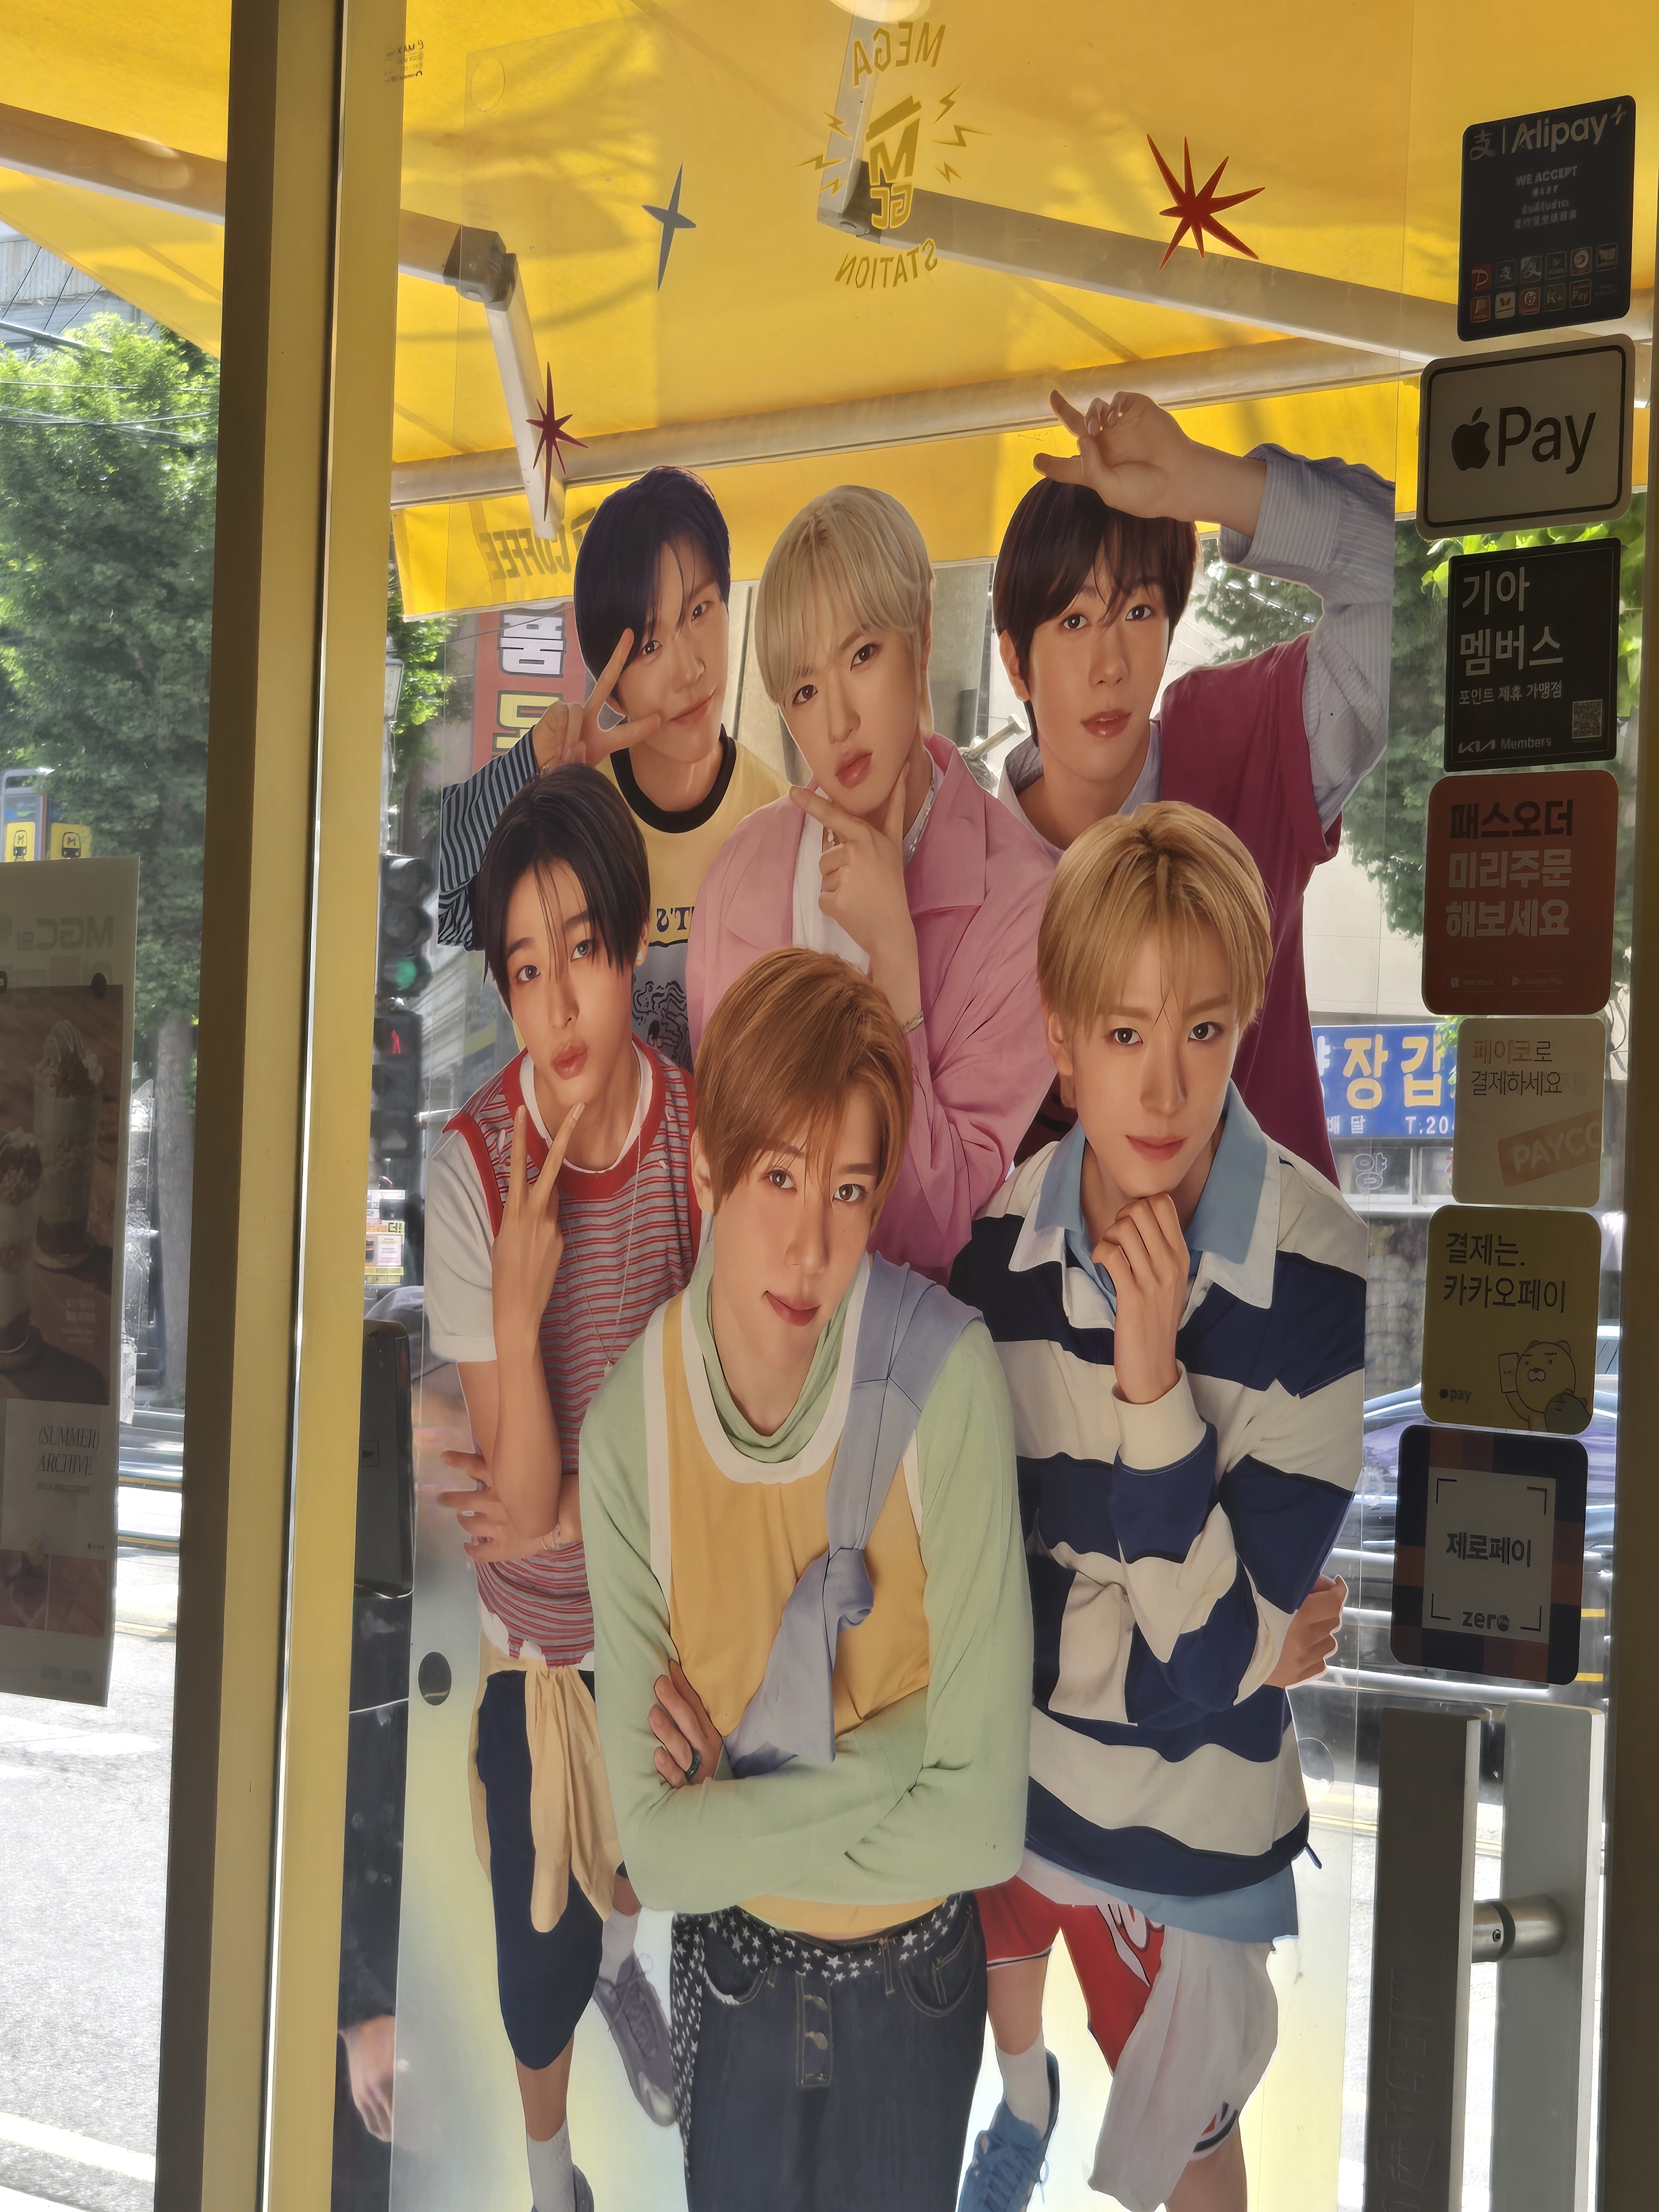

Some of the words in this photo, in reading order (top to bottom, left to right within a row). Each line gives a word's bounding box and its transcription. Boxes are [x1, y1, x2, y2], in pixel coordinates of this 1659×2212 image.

[1515, 173, 1532, 187] WE
[1498, 406, 1597, 474] Pay
[1462, 566, 1530, 615] 기아
[1460, 625, 1563, 676] 멤버스
[1459, 687, 1494, 705] 포인트
[1498, 685, 1522, 702] 제휴
[1526, 680, 1562, 700] 가맹점
[1500, 737, 1552, 750] Members
[1449, 799, 1574, 839] 패스오더
[1448, 848, 1572, 888] 미리주문
[1446, 899, 1569, 938] 해보세요
[1471, 1071, 1563, 1096] 결제하세요
[1443, 1274, 1566, 1313] 카카오페이
[34, 1452, 93, 1476] ARCHIVE
[1446, 1531, 1531, 1568] 제로페이
[1462, 1611, 1510, 1632] zero
